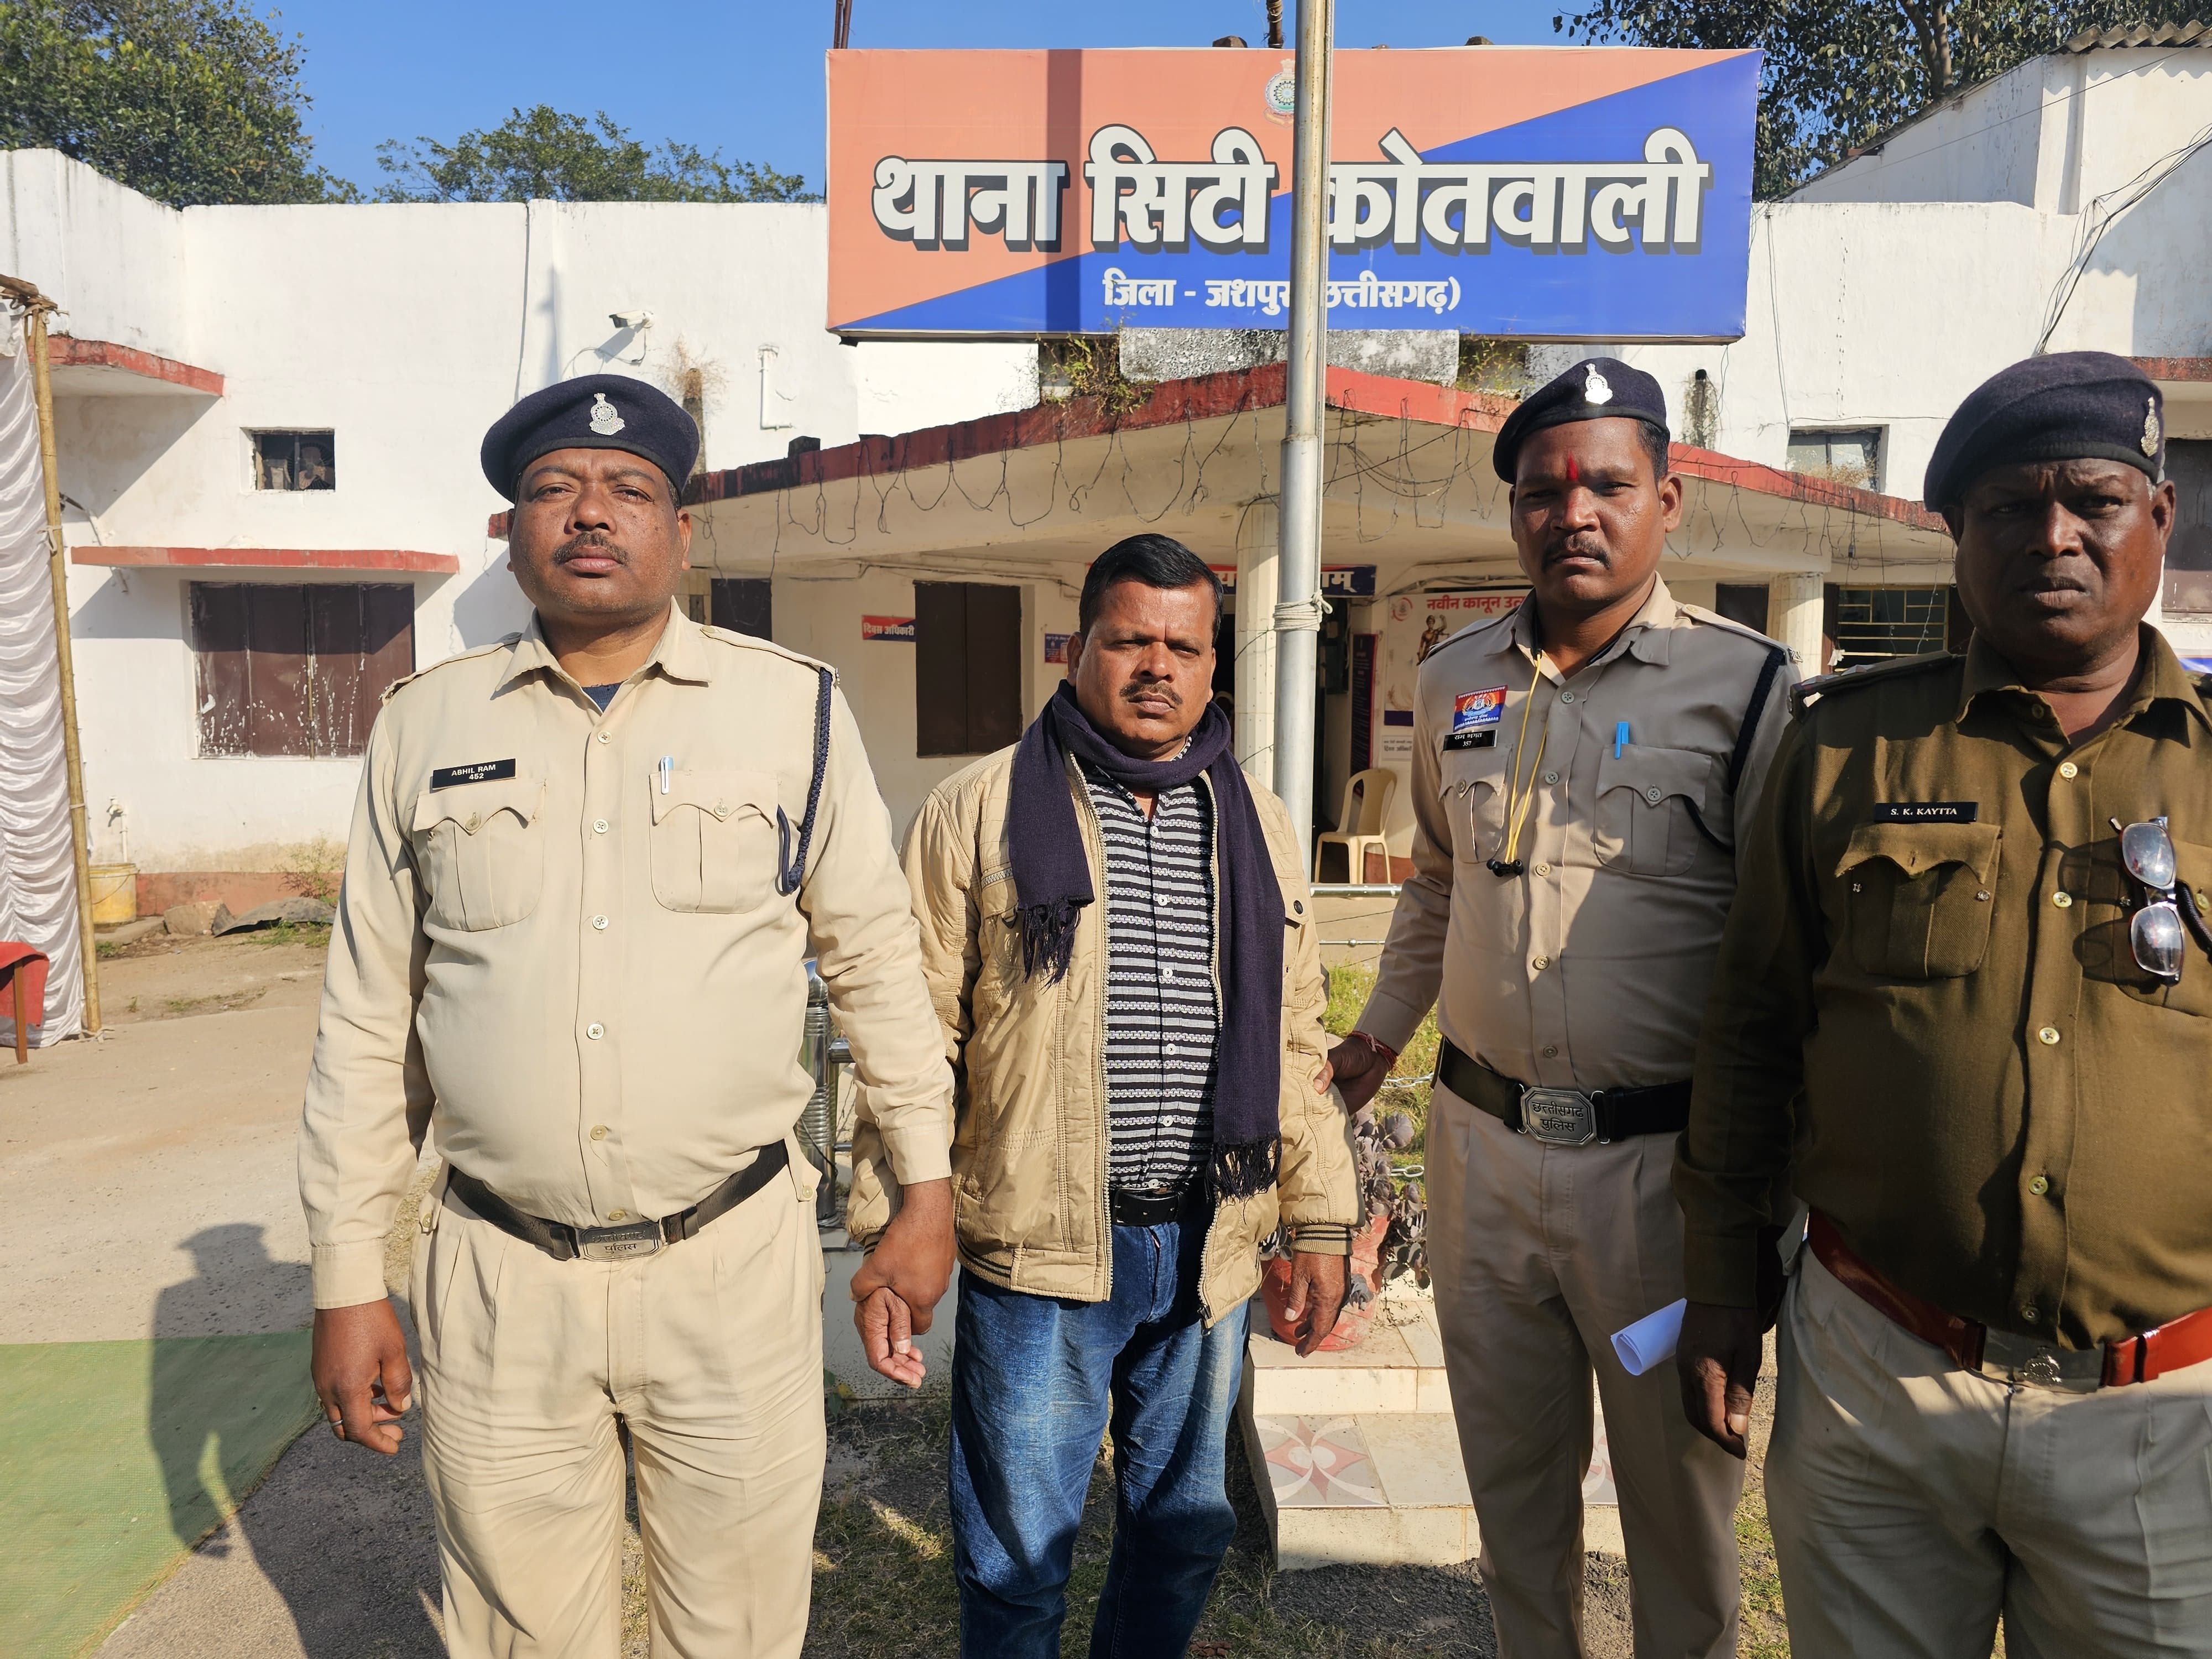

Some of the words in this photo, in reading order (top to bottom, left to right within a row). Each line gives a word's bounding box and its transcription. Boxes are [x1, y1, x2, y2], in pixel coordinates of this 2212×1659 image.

[872, 155, 1068, 251] थाना
[1083, 124, 1278, 252] सिटी
[1328, 127, 1712, 254] कोतवाली
[1102, 267, 1177, 306] जिला
[1427, 594, 1460, 610] नवीन
[1461, 596, 1501, 614] कानून
[884, 624, 915, 635] अधिकारी
[451, 768, 475, 776] ABHIL
[478, 764, 496, 773] RAM
[1540, 1117, 1576, 1132] पुलिस
[604, 1243, 637, 1254] पुलिस
